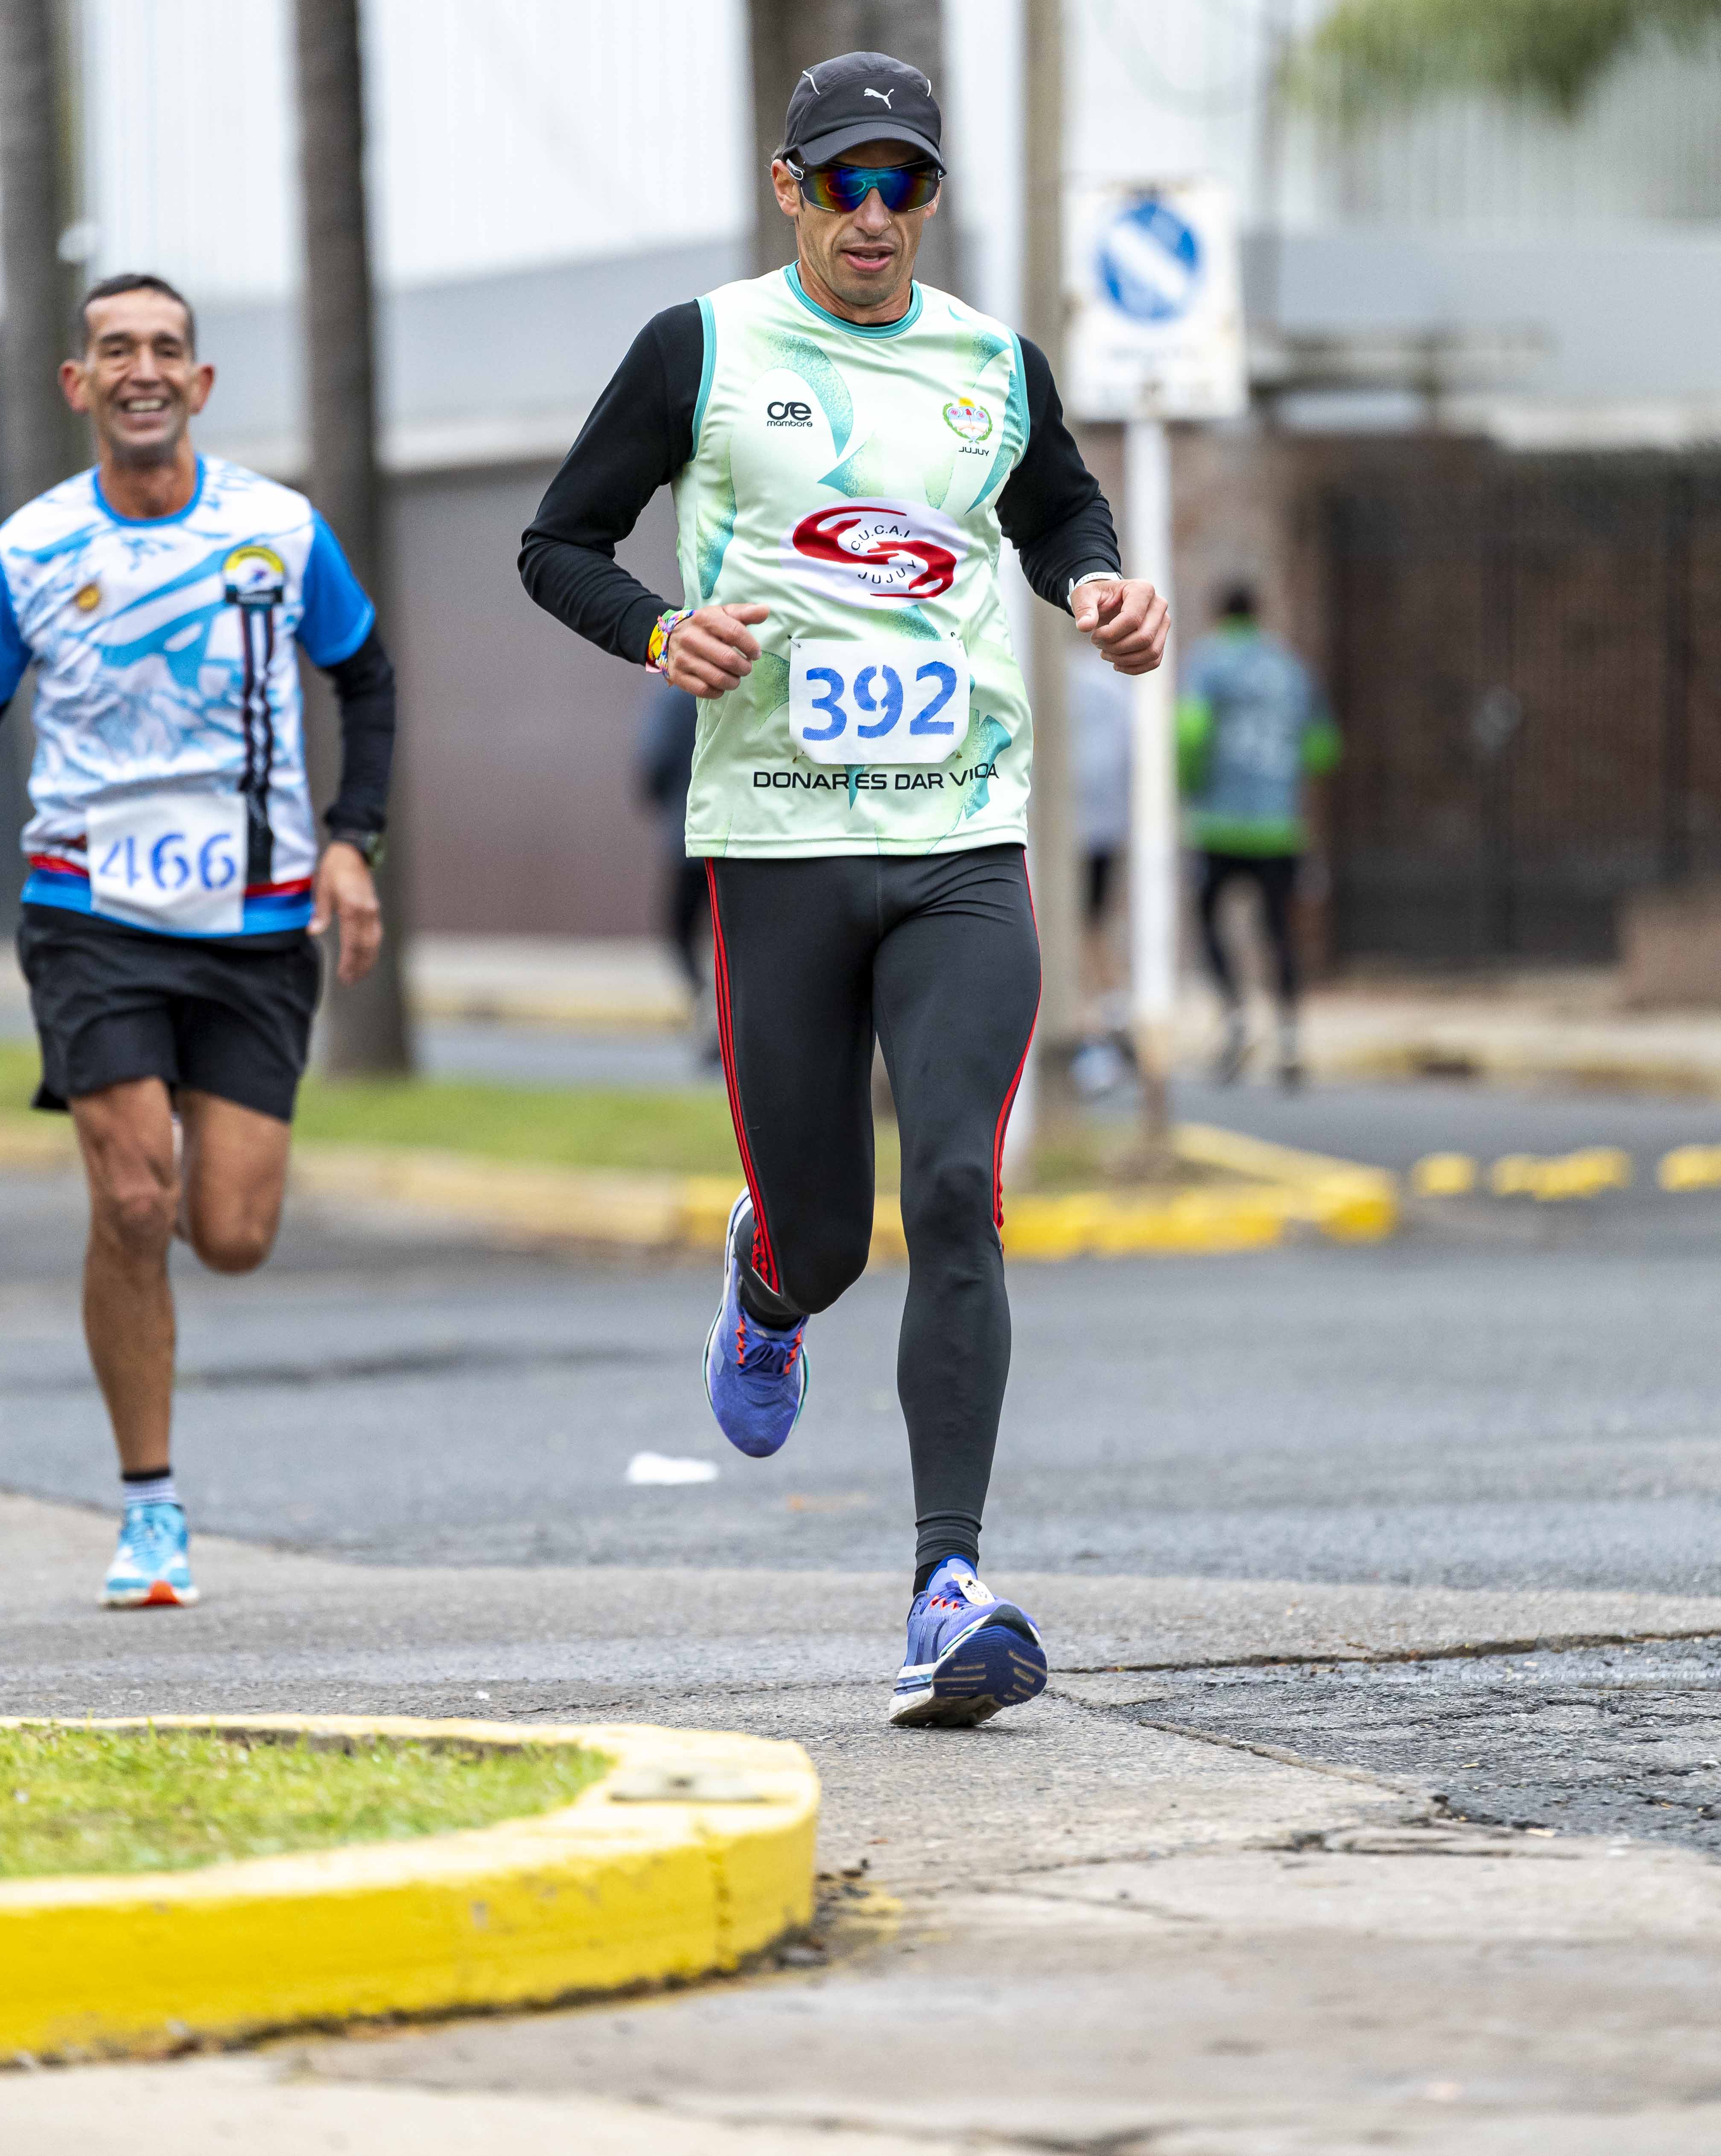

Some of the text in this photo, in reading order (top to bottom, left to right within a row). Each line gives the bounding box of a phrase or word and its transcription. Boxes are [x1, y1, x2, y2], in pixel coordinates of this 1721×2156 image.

[958, 446, 989, 456] JUJUY
[858, 560, 916, 584] JUJUY
[802, 660, 957, 741] 392
[753, 762, 1000, 790] DONAR ES DAR VIDA
[99, 833, 236, 889] 466
